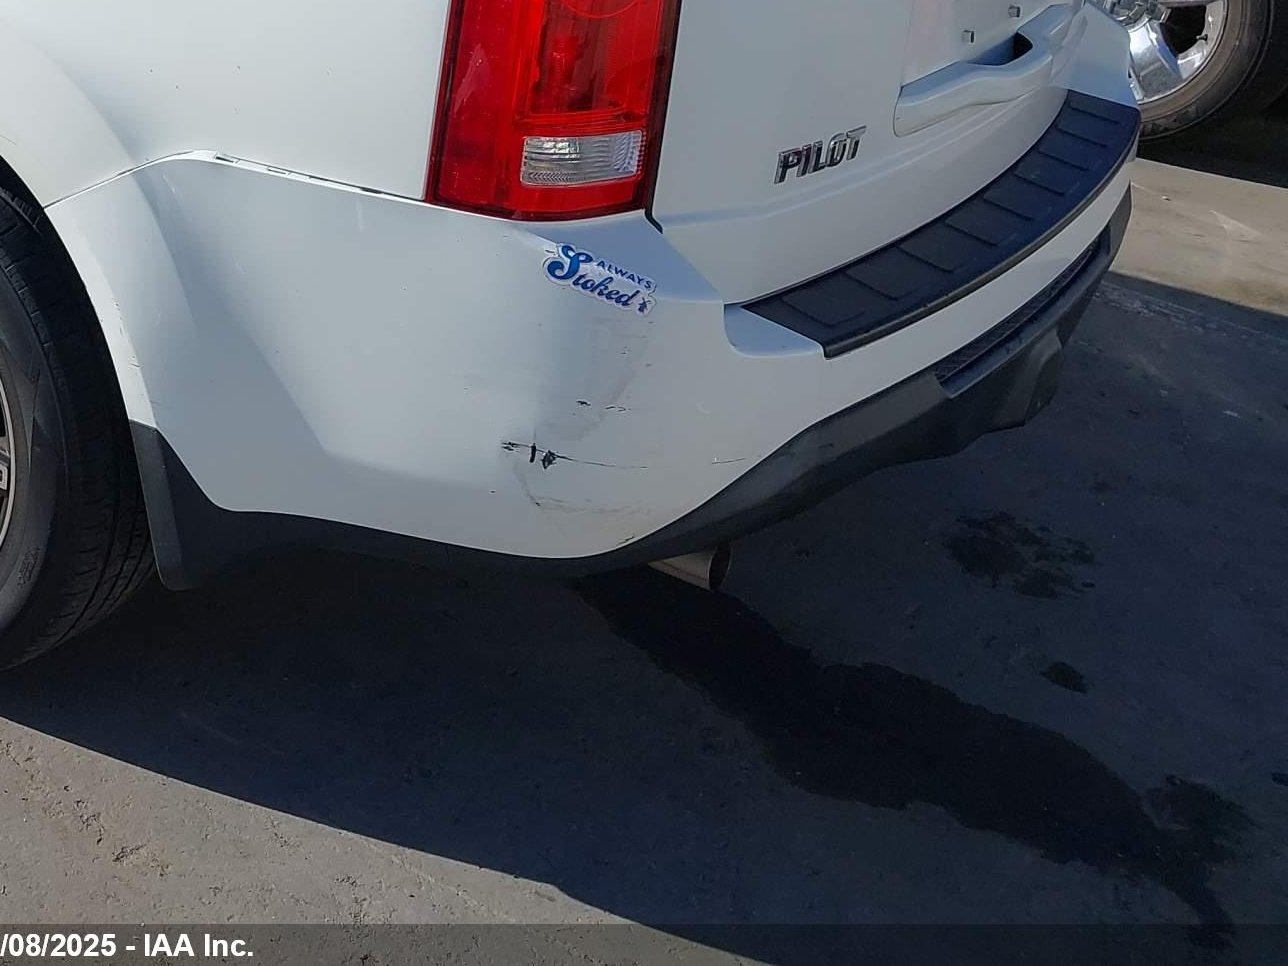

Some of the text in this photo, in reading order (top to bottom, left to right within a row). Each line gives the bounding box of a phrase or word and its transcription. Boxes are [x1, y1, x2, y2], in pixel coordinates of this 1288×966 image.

[774, 125, 867, 184] PILOT
[546, 244, 639, 308] Stoked
[596, 260, 654, 290] ALWAYS
